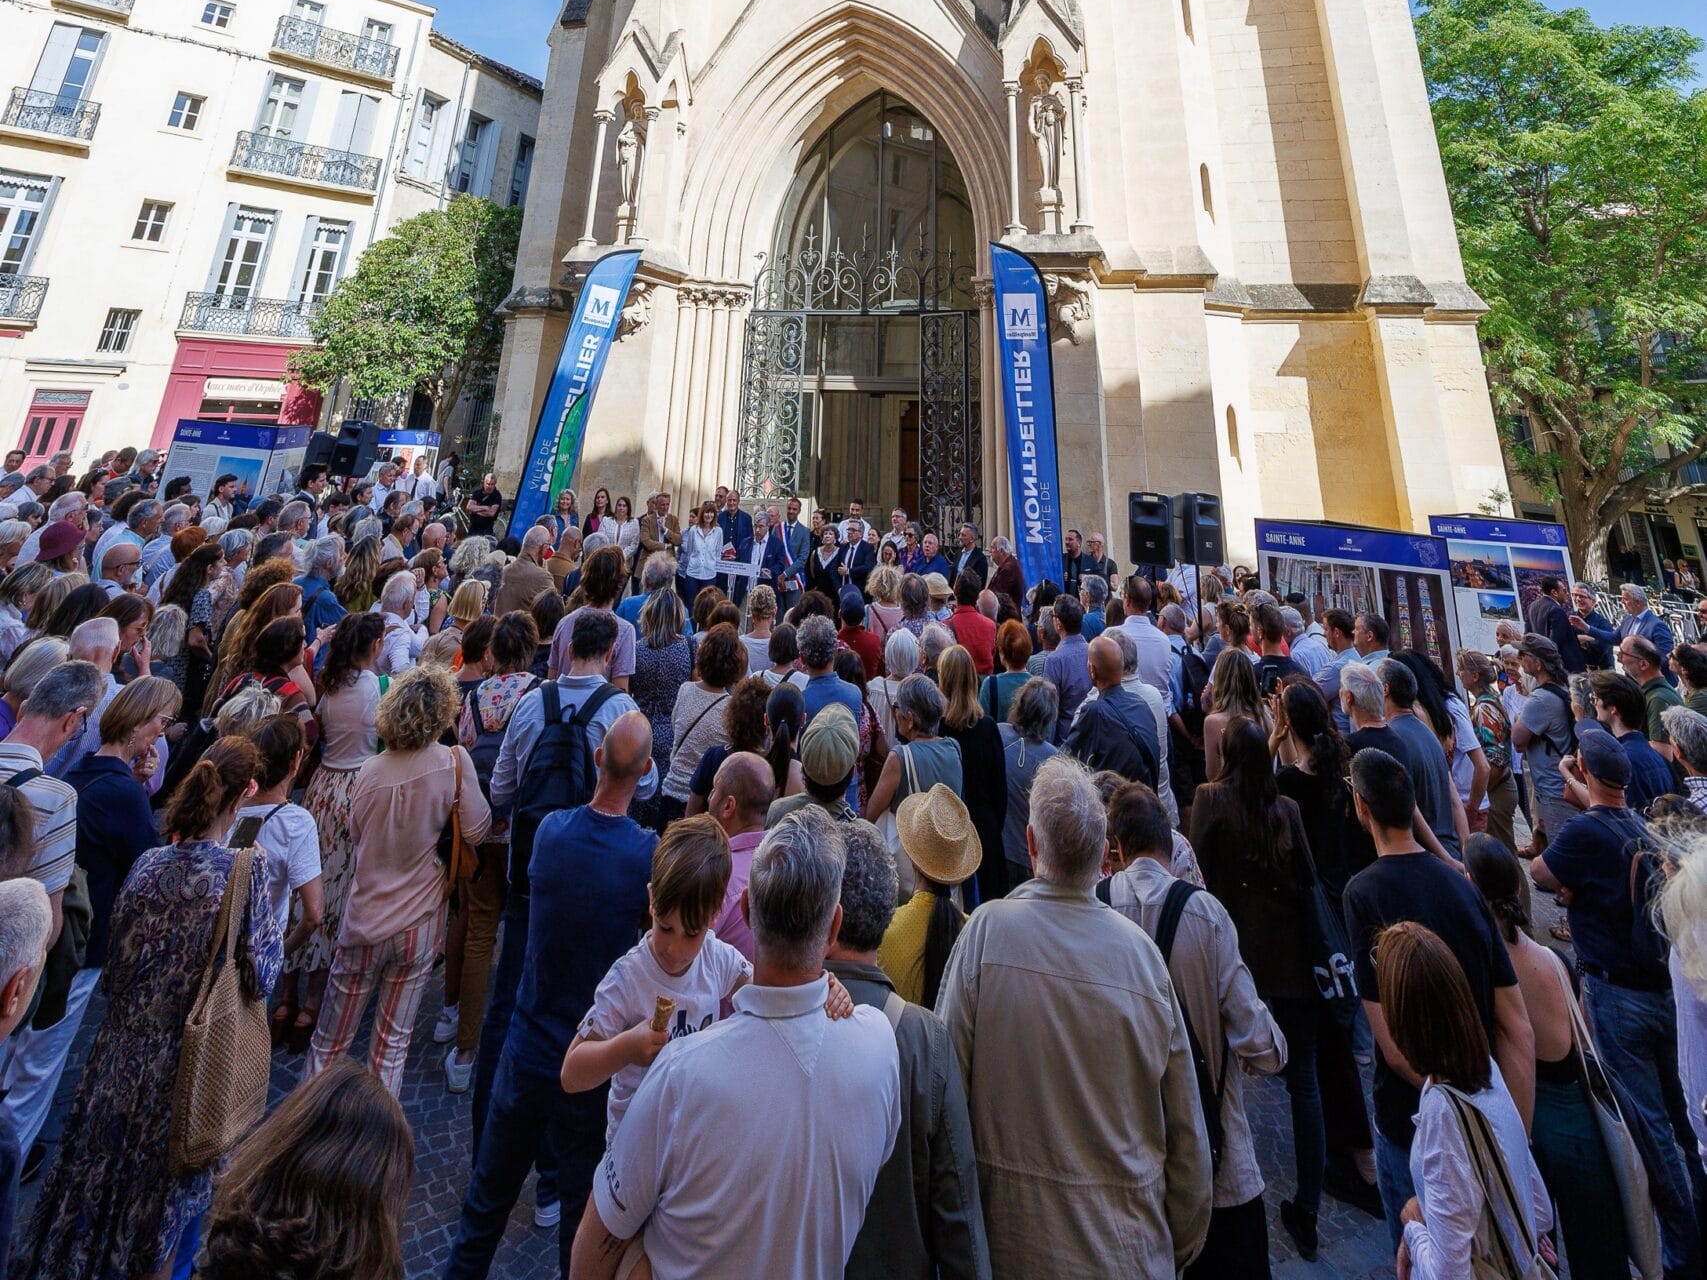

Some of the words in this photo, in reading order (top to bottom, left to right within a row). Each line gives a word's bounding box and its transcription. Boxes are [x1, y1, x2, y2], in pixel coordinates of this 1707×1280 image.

[591, 298, 610, 316] M
[529, 458, 546, 490] VILLE
[540, 439, 552, 456] DE
[1437, 524, 1467, 535] SAINTE-ANNE
[1265, 532, 1306, 547] SAINTE-ANNE
